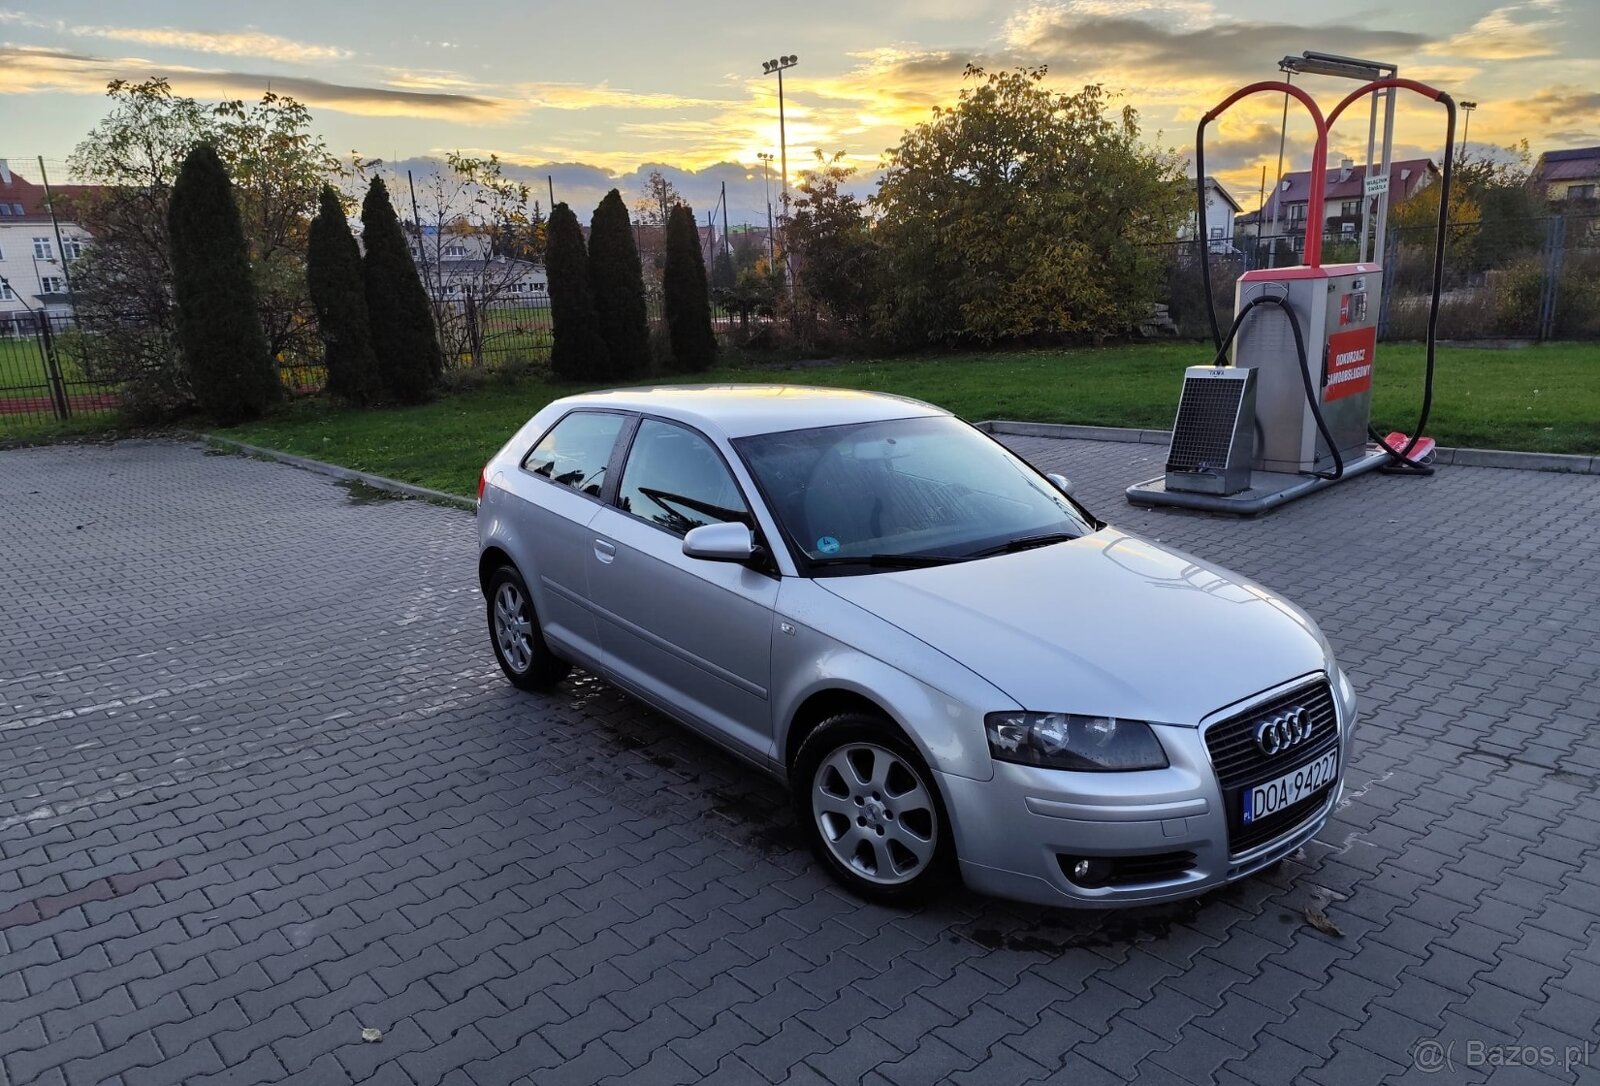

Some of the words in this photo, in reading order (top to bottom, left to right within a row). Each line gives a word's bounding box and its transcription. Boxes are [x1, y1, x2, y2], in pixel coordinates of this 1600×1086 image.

[1253, 778, 1288, 819] DOA
[1294, 752, 1337, 801] 94227
[1243, 811, 1251, 820] PL
